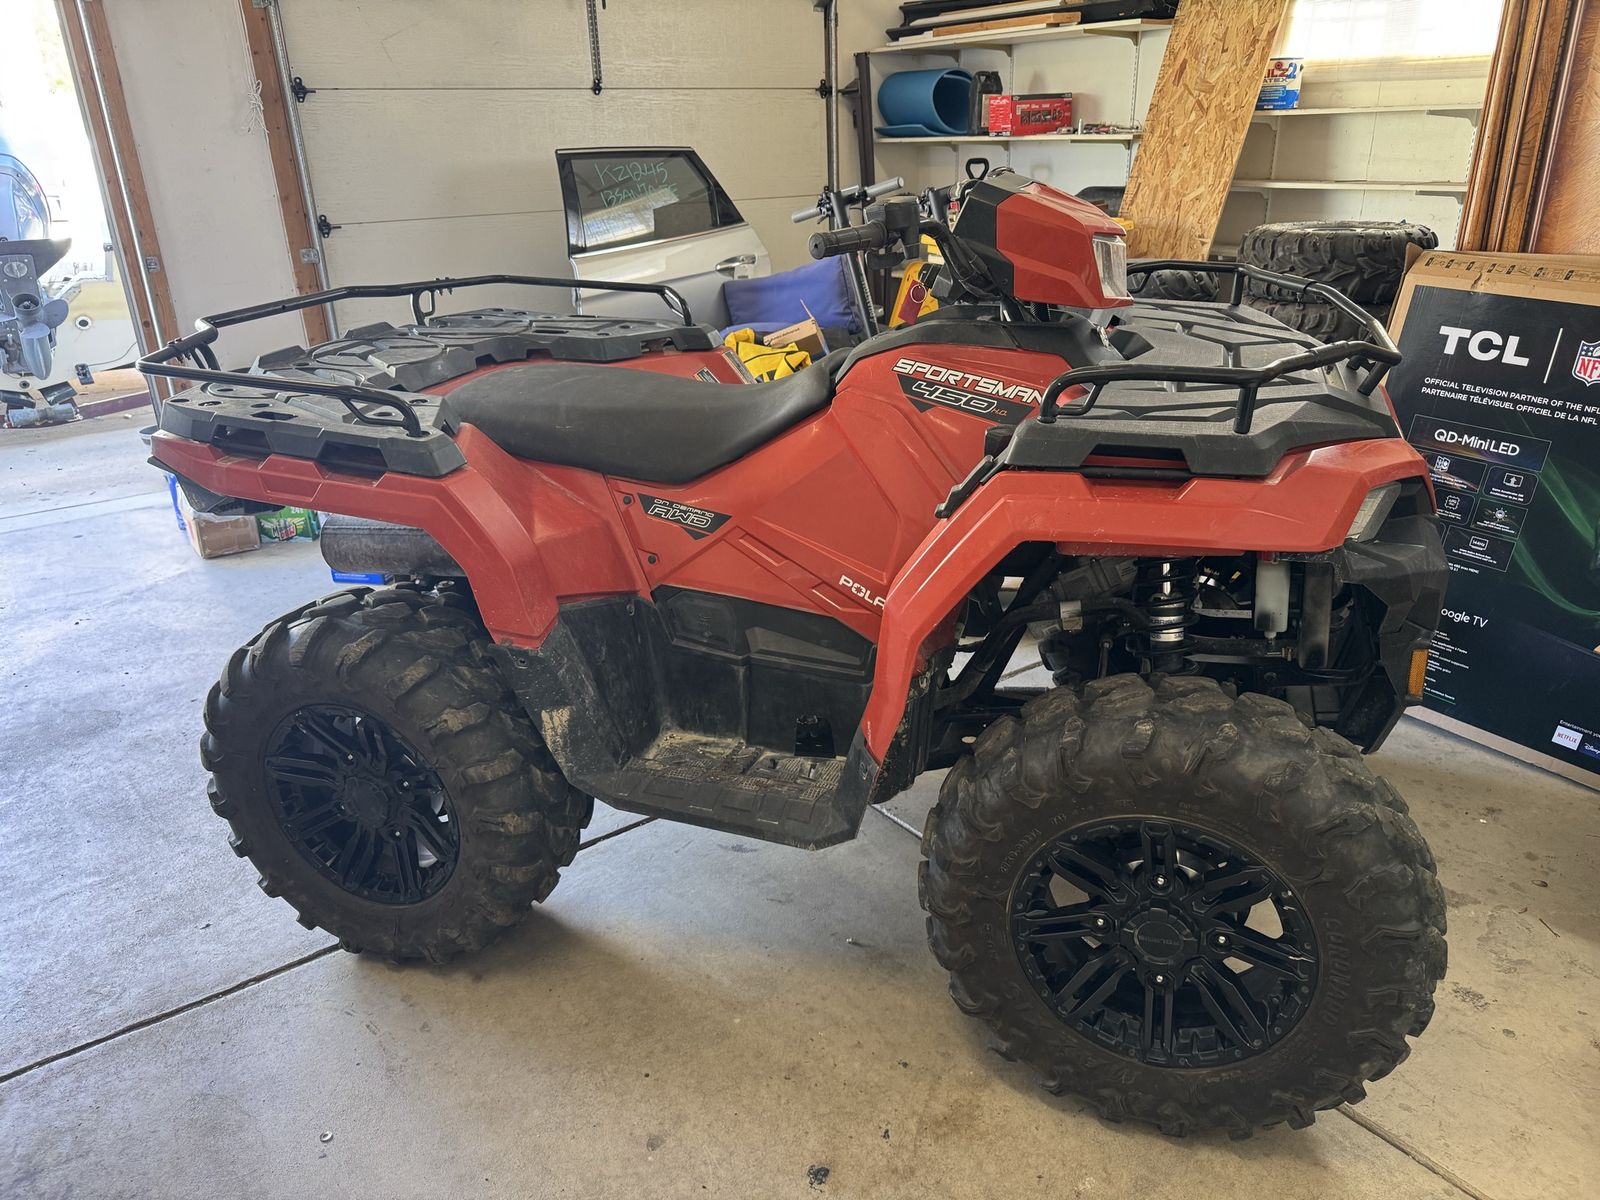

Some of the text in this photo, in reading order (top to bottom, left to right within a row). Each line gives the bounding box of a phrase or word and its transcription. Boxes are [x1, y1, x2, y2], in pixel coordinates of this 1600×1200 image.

[1264, 67, 1289, 78] ILZ
[1439, 325, 1529, 367] TCL
[892, 358, 1043, 404] SPORTSMAN
[912, 381, 998, 413] 450
[1424, 377, 1460, 390] OFFICIAL
[1462, 383, 1508, 398] TELEVISION
[1509, 392, 1549, 405] PARTNER
[1550, 399, 1564, 407] OF
[1565, 402, 1583, 411] THE
[1421, 386, 1598, 426] PARTENAIRE TÉLÉVISUEL OFFICIEL DE LA NFL
[648, 504, 711, 528] AWD
[839, 574, 885, 610] POLA
[1441, 608, 1488, 628] oogle TV
[1556, 732, 1577, 743] NETFLIX
